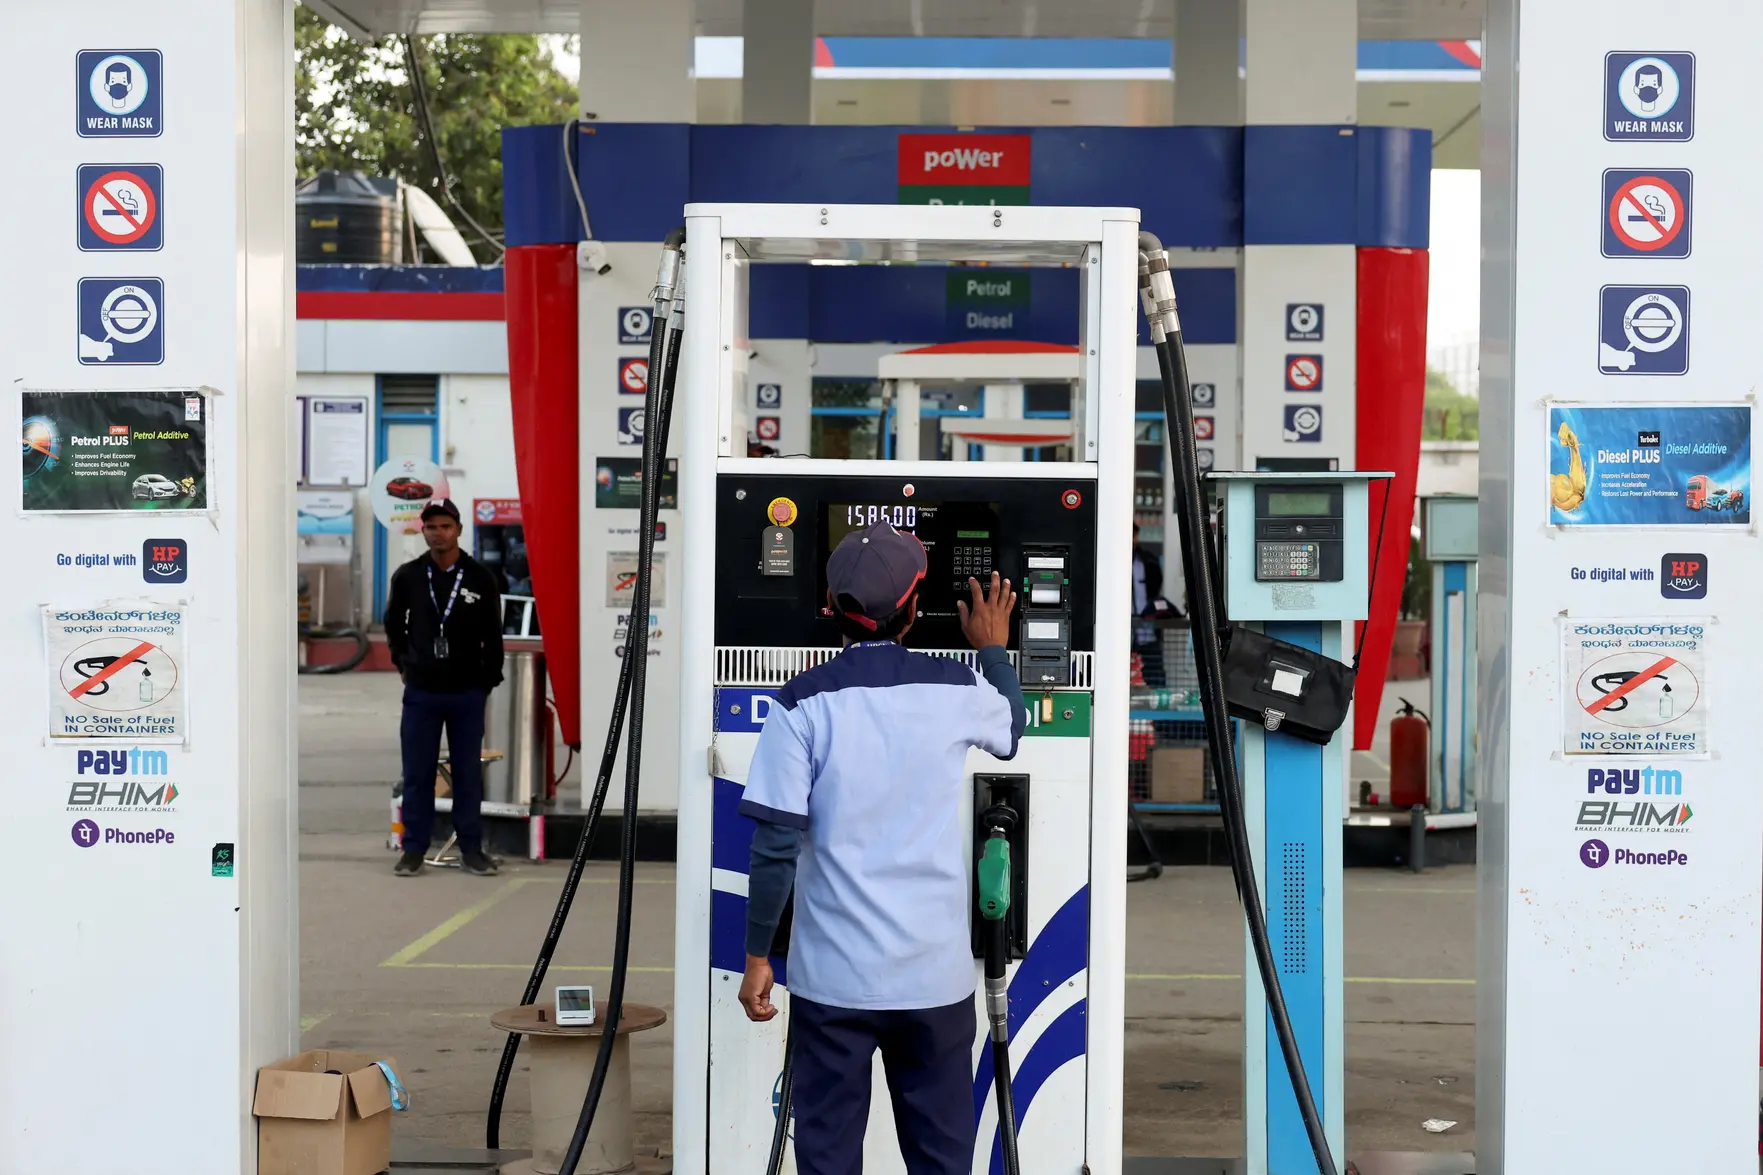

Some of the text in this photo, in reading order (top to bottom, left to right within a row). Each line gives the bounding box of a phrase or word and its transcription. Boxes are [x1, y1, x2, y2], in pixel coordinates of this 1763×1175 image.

[87, 117, 153, 130] WEAR MASK
[1614, 121, 1684, 133] WEAR MASK
[967, 280, 1011, 296] Petrol
[966, 312, 1013, 329] Diesel
[71, 436, 129, 446] Petrol PLUS
[133, 431, 189, 440] Petrol Additive
[1666, 443, 1727, 455] Diesel Additive
[75, 453, 99, 461] Improves
[112, 453, 136, 461] Economy
[1598, 450, 1660, 464] Diesel PLUS
[101, 461, 118, 469] Engine
[100, 470, 127, 478] Drivability
[1601, 472, 1620, 480] Improves
[1631, 472, 1650, 480] Economy
[153, 546, 180, 561] HP
[57, 554, 136, 568] Go digital with
[157, 563, 174, 571] PAY
[1571, 567, 1654, 582] Go digital with
[1671, 561, 1699, 577] HP
[1675, 578, 1693, 586] PAY
[65, 715, 174, 724] NO Sale of Fuel
[65, 725, 175, 733] IN CONTAINERS
[1581, 732, 1696, 741] NO Sale of Fuel
[1580, 742, 1695, 751] IN CONTAINERS
[67, 782, 167, 806] BHIM
[1576, 801, 1680, 826] BHIM
[78, 823, 93, 843] पे
[105, 828, 174, 843] PhonePe
[1587, 843, 1602, 864] पे
[1615, 848, 1688, 865] PhonePe
